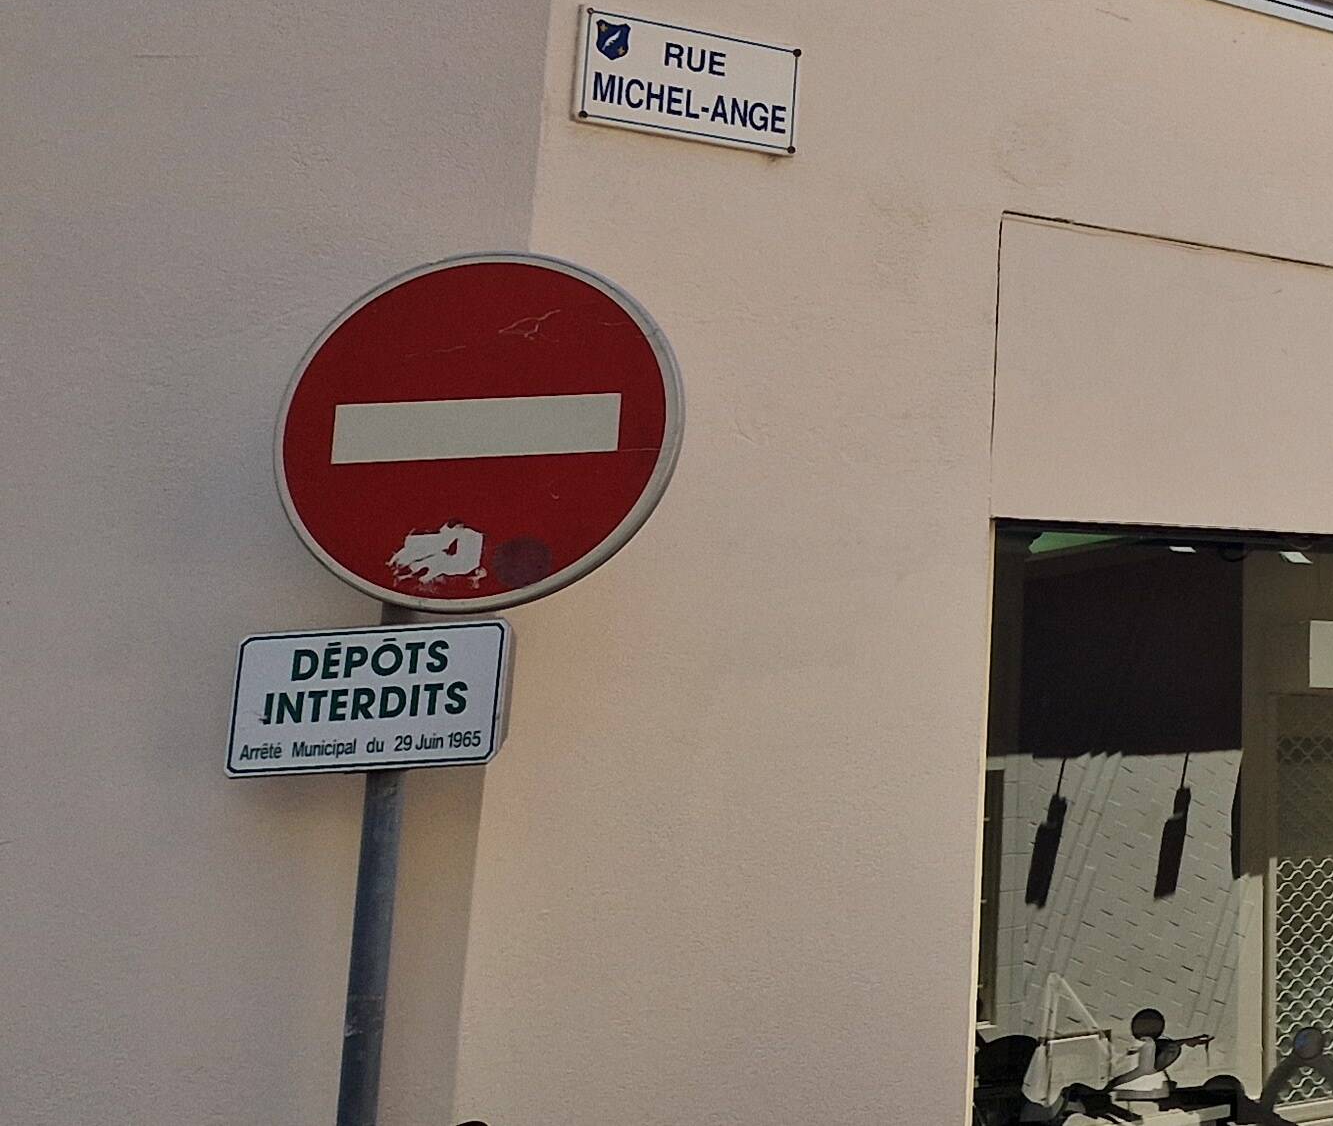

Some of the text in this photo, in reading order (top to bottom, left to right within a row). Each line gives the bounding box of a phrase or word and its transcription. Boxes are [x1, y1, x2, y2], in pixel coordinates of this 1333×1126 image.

[664, 42, 726, 76] RUE
[592, 71, 787, 134] MICHEL-ANGE
[291, 637, 449, 681] DÉPÔTS
[262, 681, 468, 724] INTERDITS
[239, 730, 481, 761] Arrêté Municipal du 29 Juin 1965
